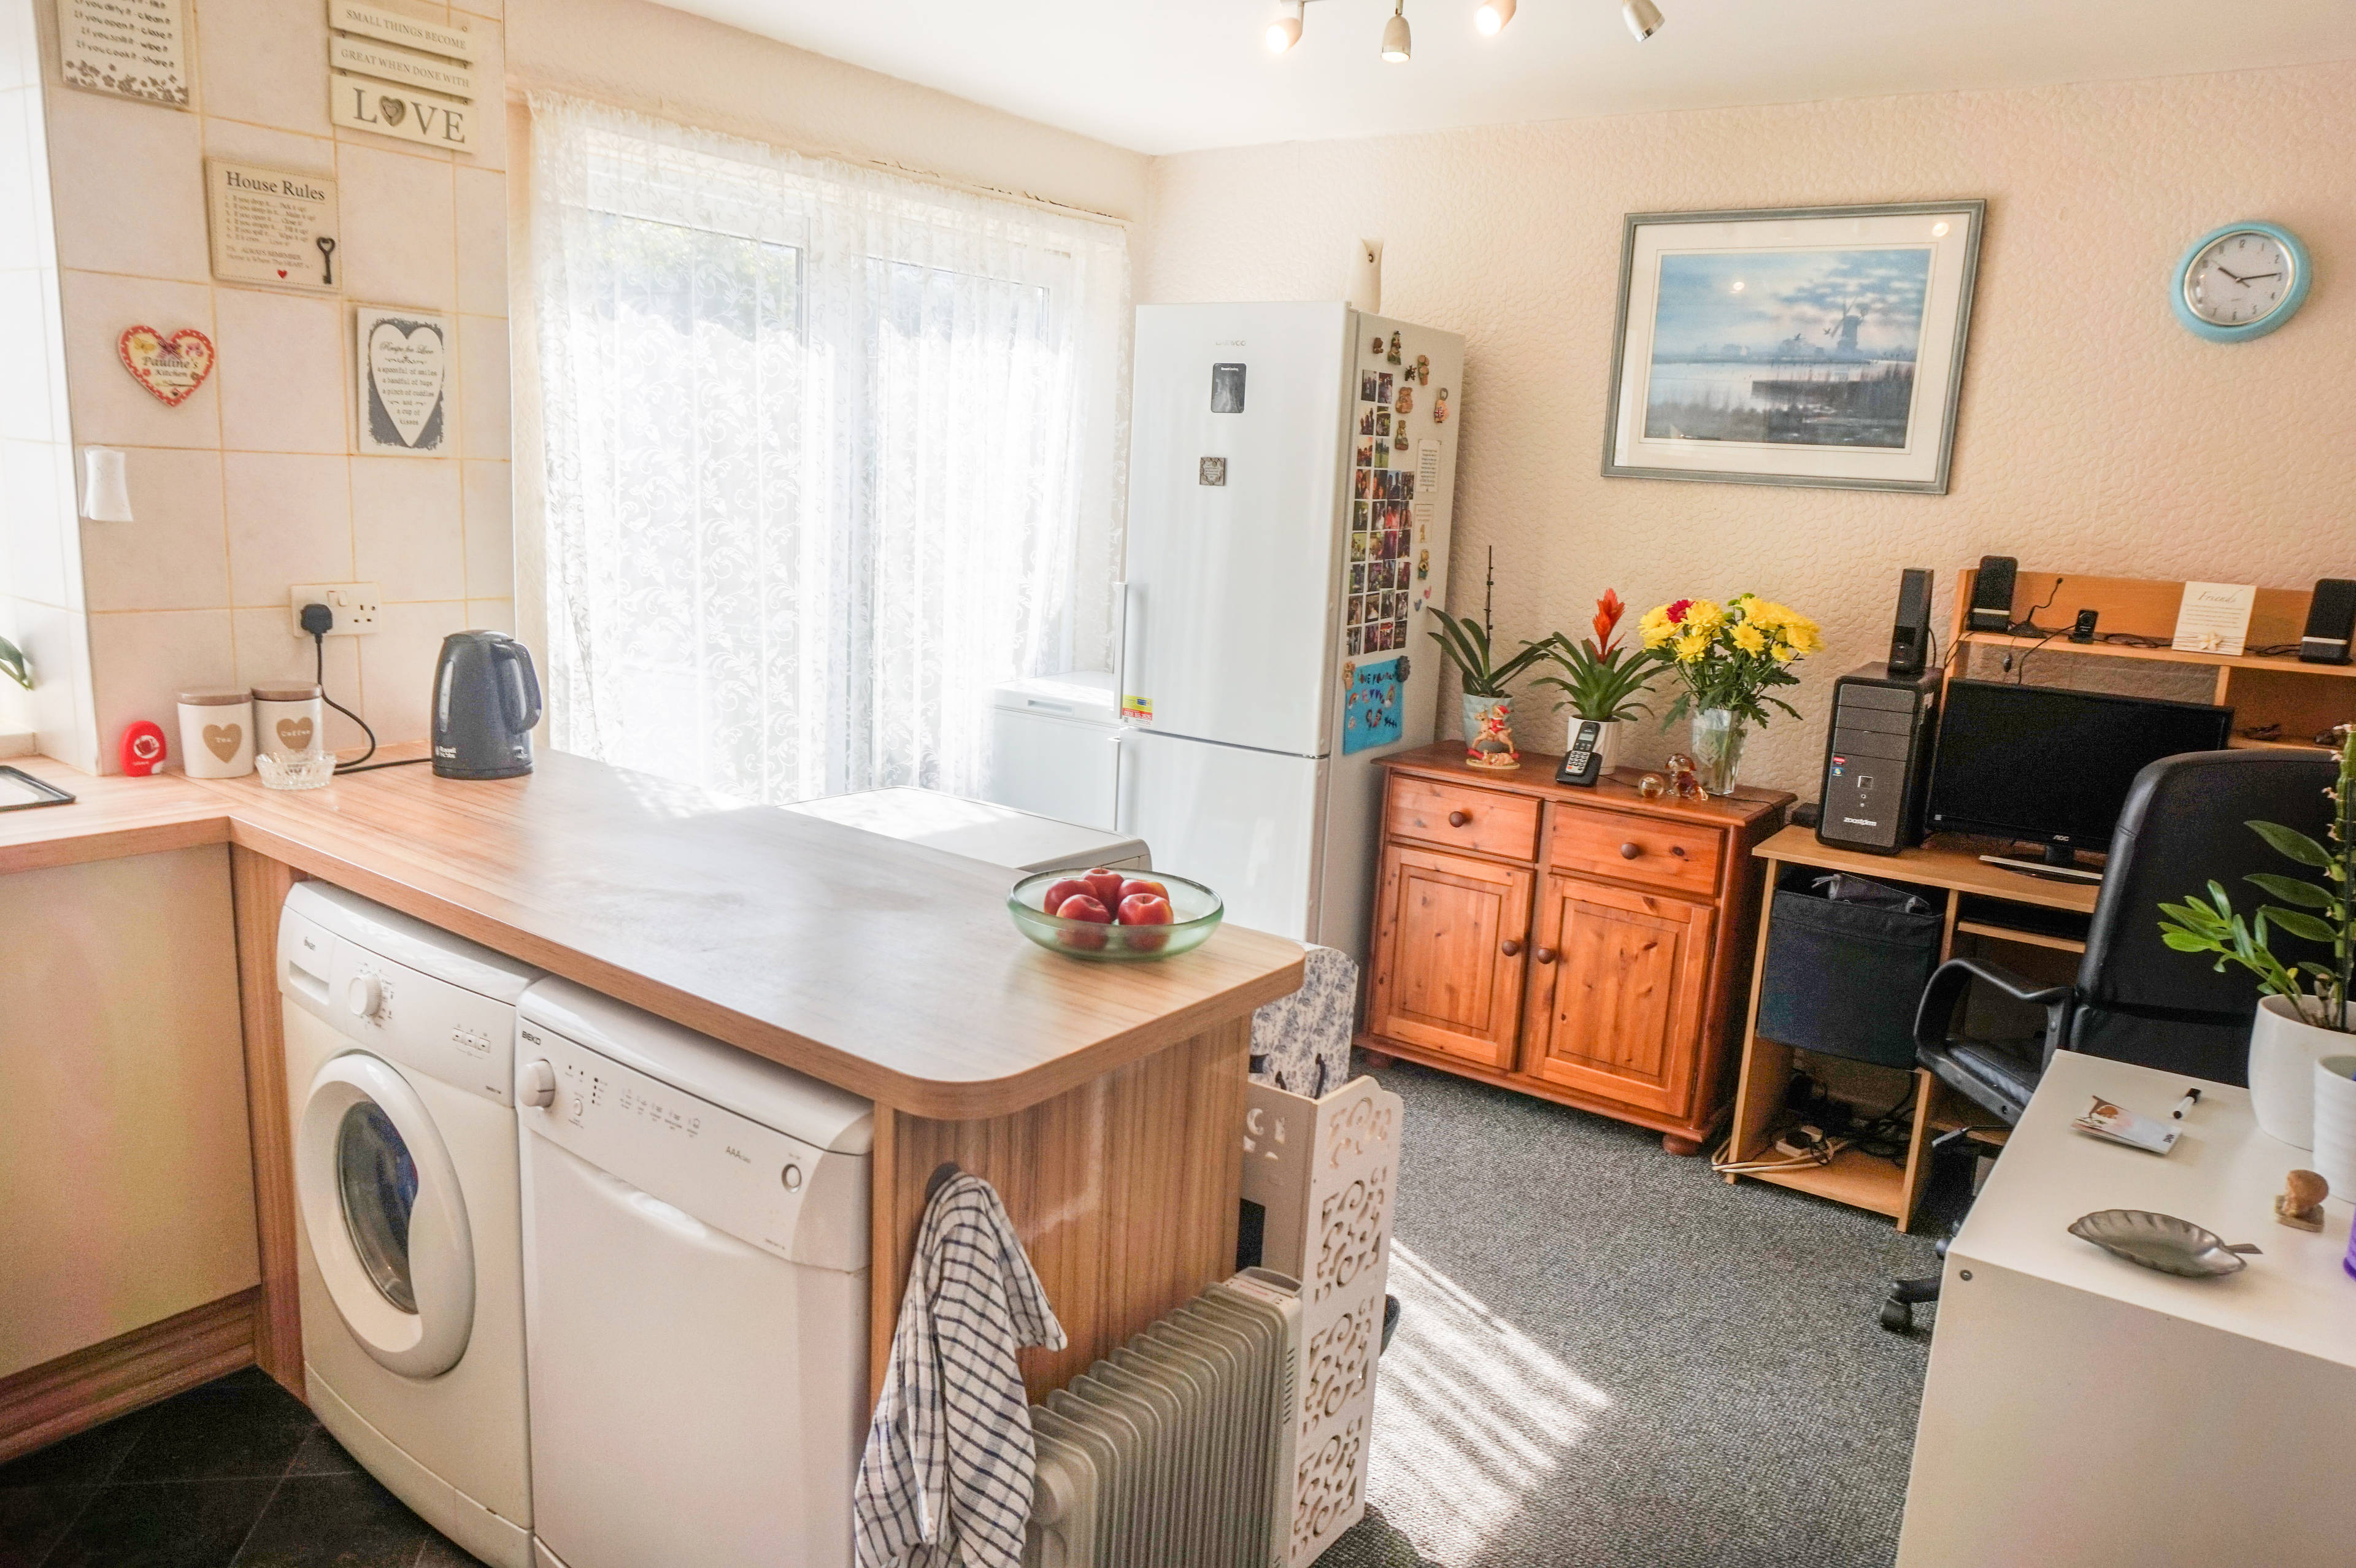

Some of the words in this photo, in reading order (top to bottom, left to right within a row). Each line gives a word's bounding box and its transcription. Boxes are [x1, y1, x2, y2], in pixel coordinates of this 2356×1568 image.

[138, 12, 164, 23] clean
[85, 15, 103, 24] you
[104, 19, 128, 29] open
[141, 27, 166, 39] close
[346, 10, 382, 27] SMALL
[383, 20, 423, 37] THINGS
[425, 31, 466, 50] BECOME
[87, 45, 106, 55] you
[142, 56, 167, 67] share
[140, 42, 161, 53] wipe
[341, 49, 377, 65] GREAT
[378, 58, 411, 74] WHEN
[414, 67, 441, 81] DONE
[442, 74, 470, 88] WITH
[226, 171, 278, 193] House
[282, 180, 326, 201] Rules
[141, 356, 199, 369] Pauline's
[156, 369, 188, 377] Kitchen
[522, 1030, 541, 1045] BEKO
